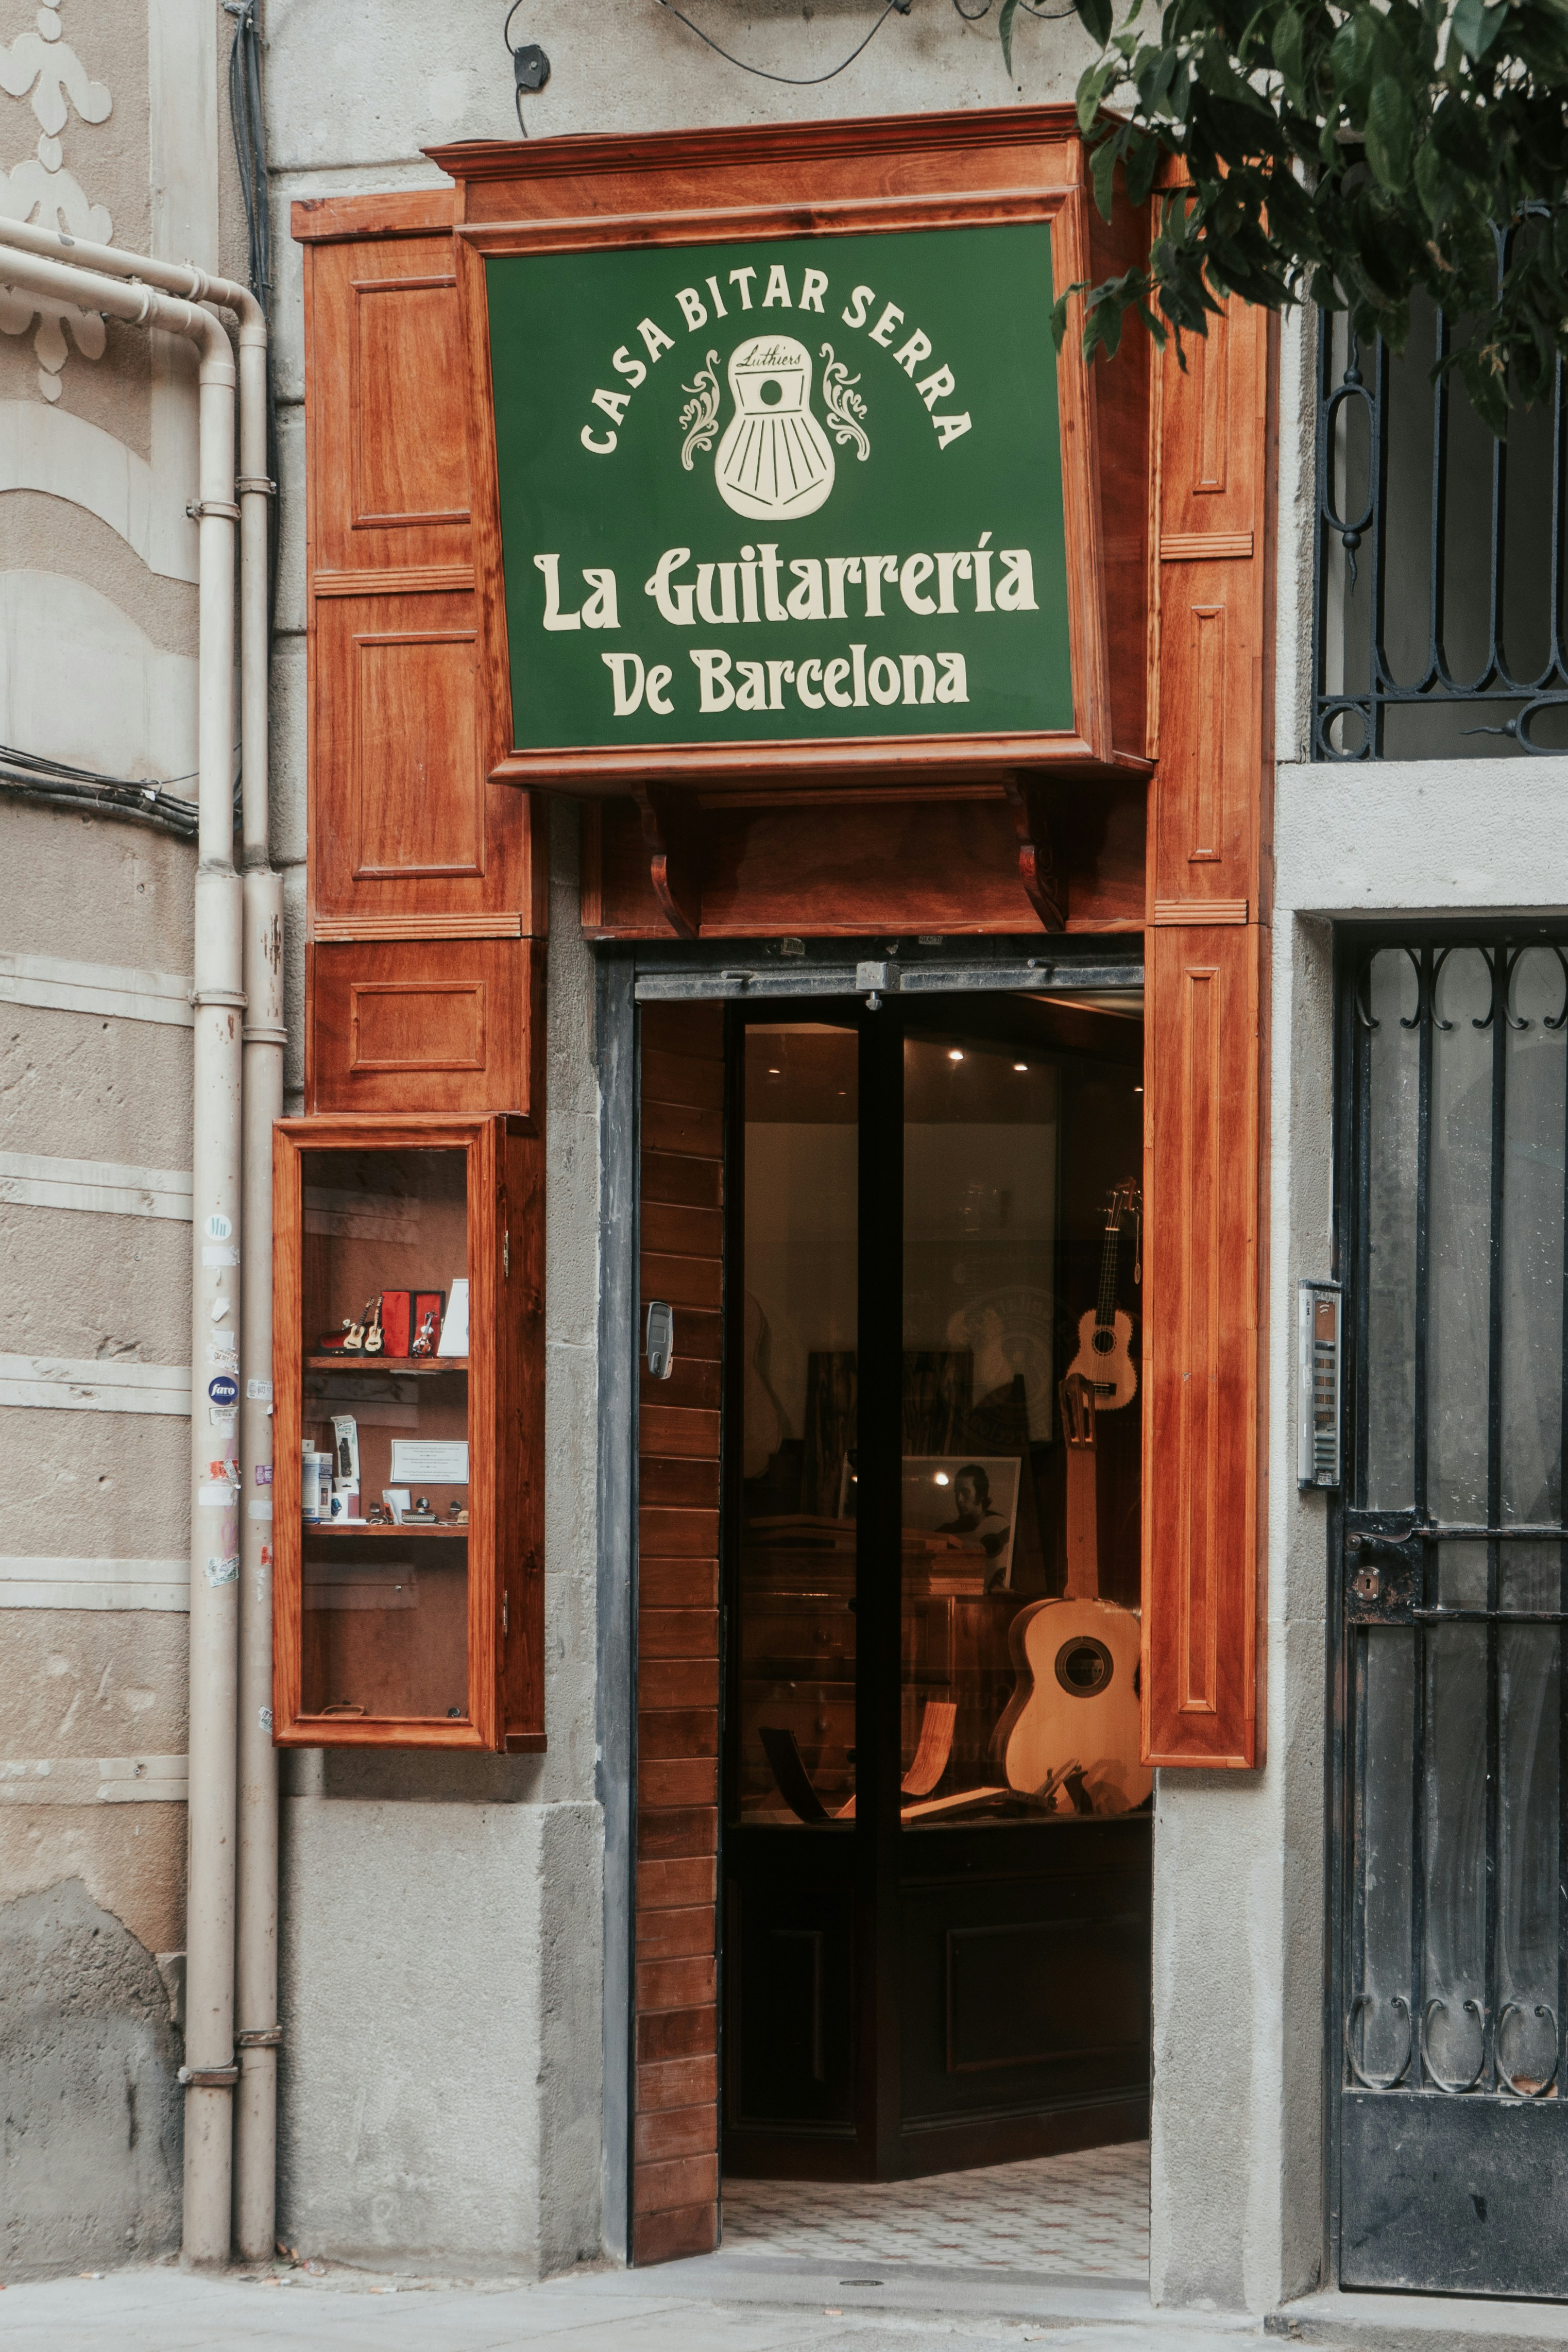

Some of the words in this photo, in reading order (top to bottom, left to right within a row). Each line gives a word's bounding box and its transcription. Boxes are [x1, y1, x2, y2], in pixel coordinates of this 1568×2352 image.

[581, 317, 675, 454] CASA
[675, 265, 828, 332] BITAR
[841, 285, 972, 450] SERRA
[736, 344, 802, 367] Luthiers
[533, 554, 621, 631] La
[644, 531, 1039, 625] Guitarrería
[601, 653, 674, 716] De
[689, 644, 970, 713] Barcelona
[211, 1384, 235, 1396] faro
